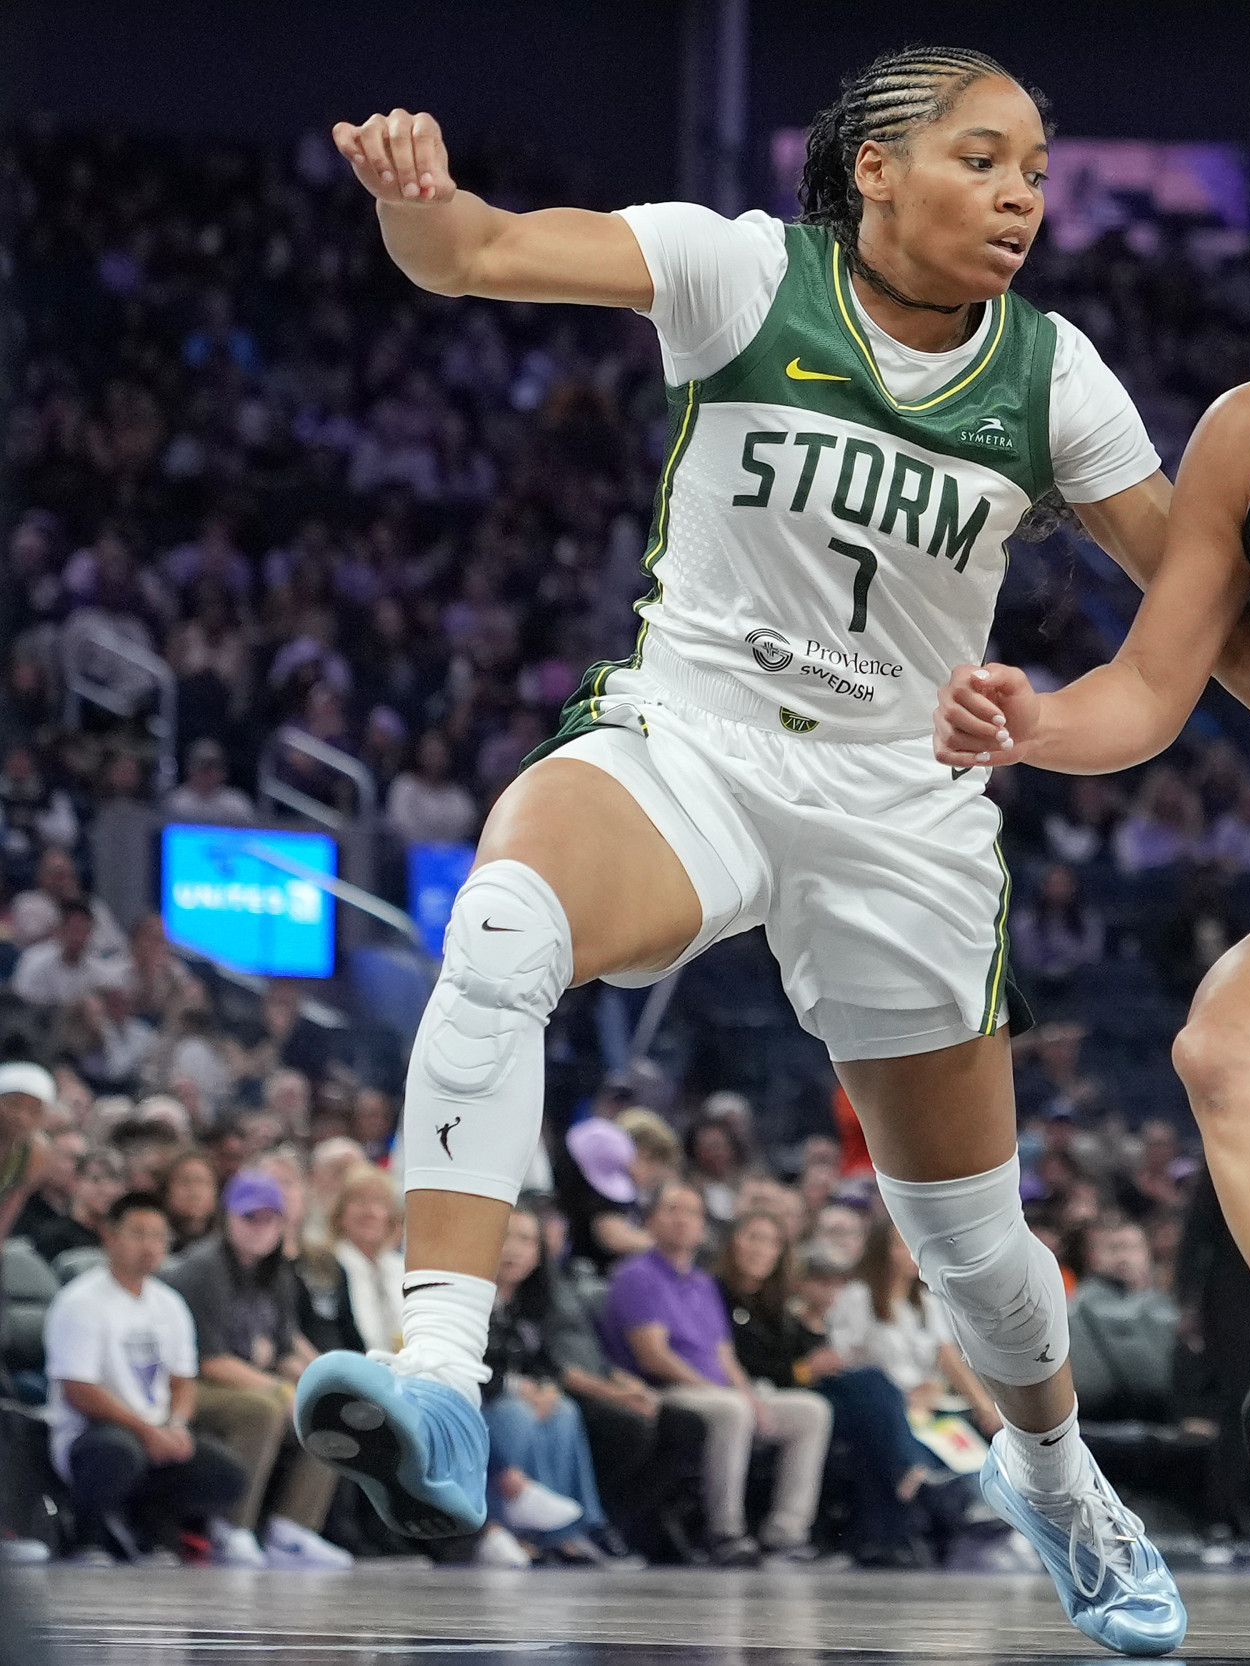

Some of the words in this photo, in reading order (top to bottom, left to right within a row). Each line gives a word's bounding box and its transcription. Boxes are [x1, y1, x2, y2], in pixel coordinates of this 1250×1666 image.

[961, 431, 1013, 448] SYMETRA
[733, 430, 991, 574] STORM
[828, 537, 878, 633] 7
[804, 639, 903, 678] Provdence
[801, 665, 874, 702] SWEDISH
